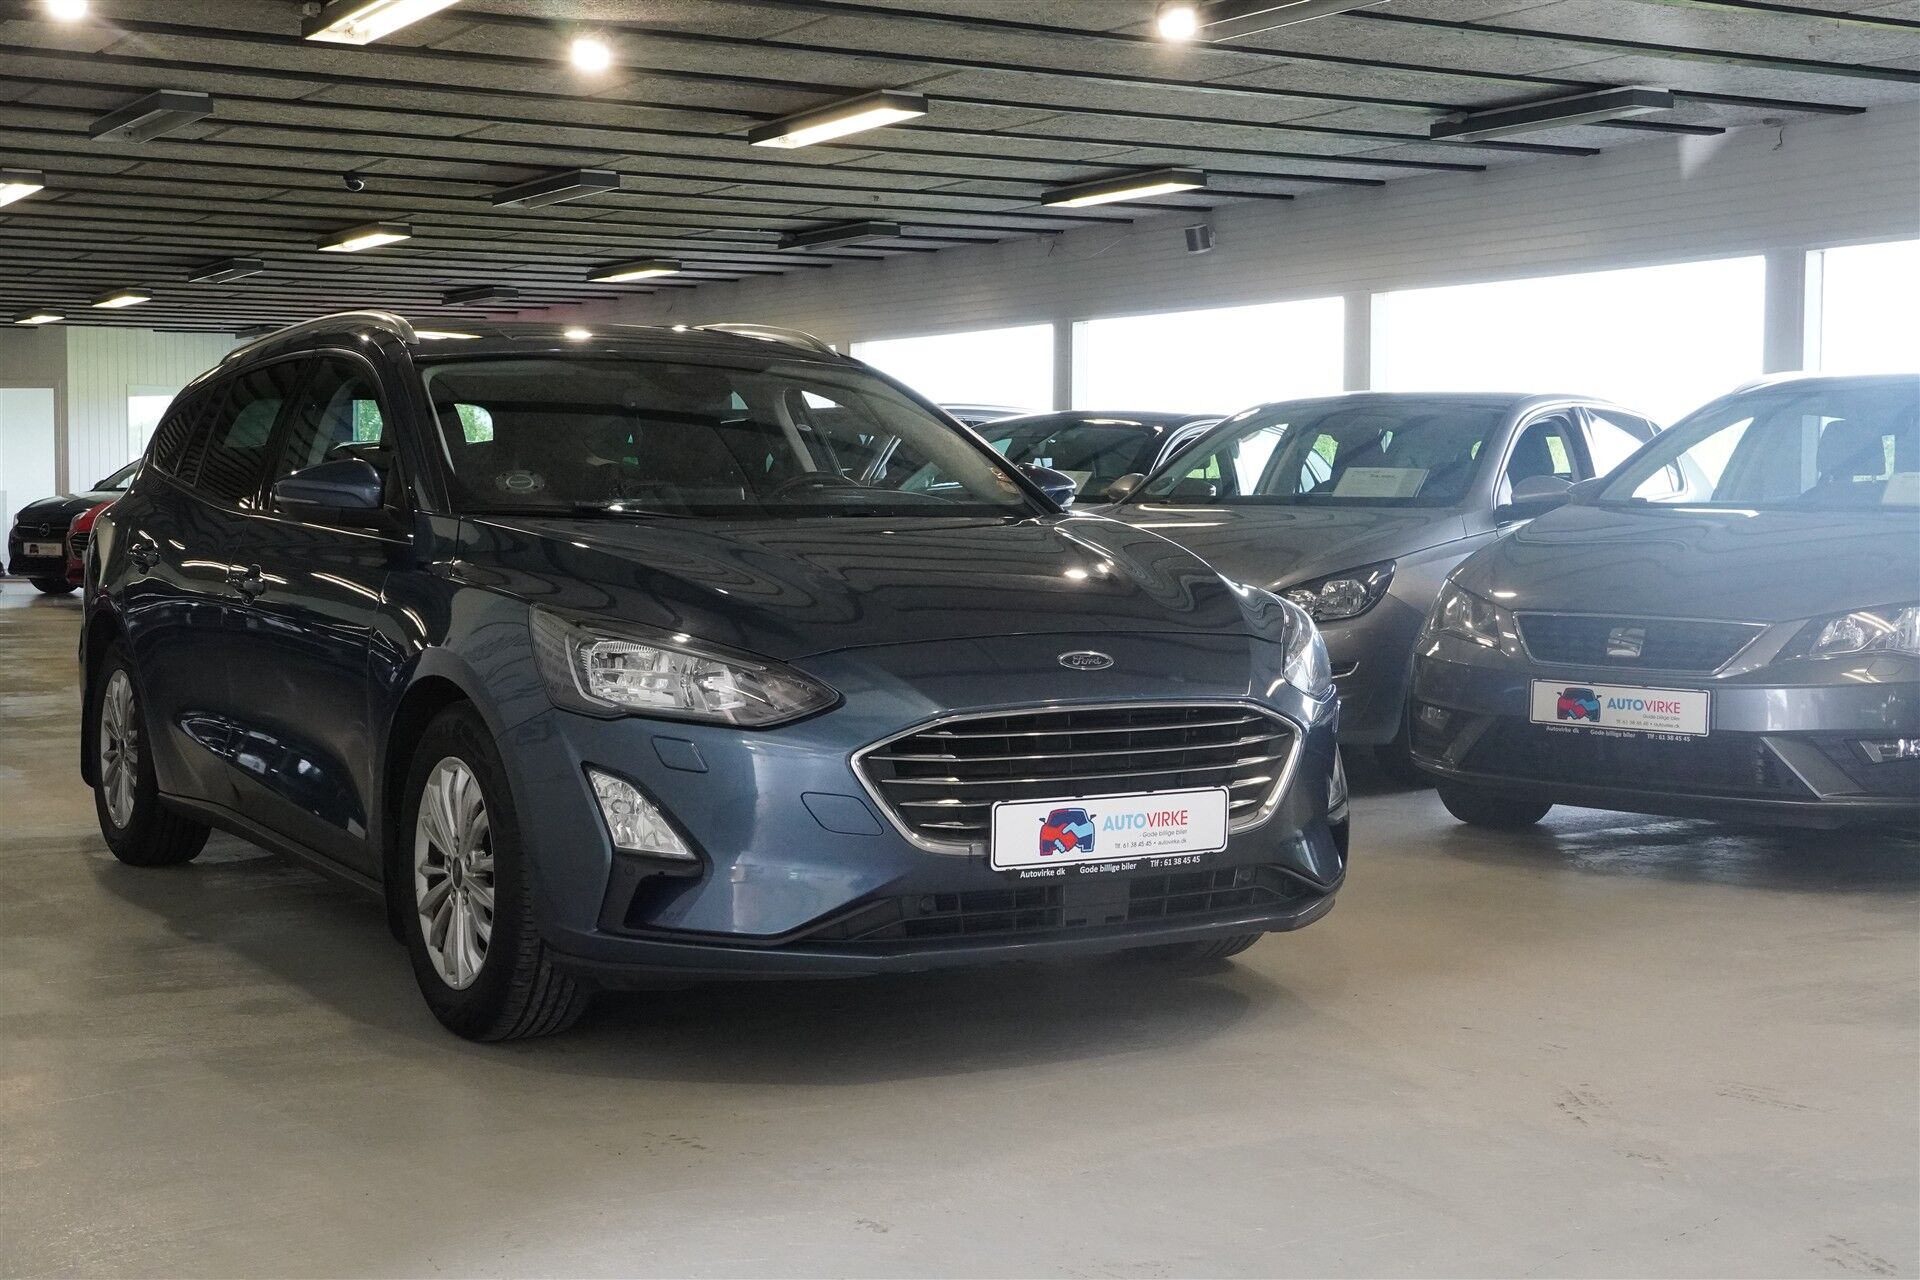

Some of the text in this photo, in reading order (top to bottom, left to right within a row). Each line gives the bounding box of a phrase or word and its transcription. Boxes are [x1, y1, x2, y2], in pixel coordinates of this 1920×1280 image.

[1607, 698, 1681, 714] AUTOVIRKE
[1102, 810, 1188, 831] AUTOVIRKE
[1080, 866, 1099, 874] Gode
[1099, 863, 1120, 873] billige
[1121, 862, 1137, 871] biler
[1163, 858, 1172, 866] 61
[1173, 857, 1182, 865] 38
[1182, 856, 1191, 864] 45
[1191, 855, 1201, 863] 45
